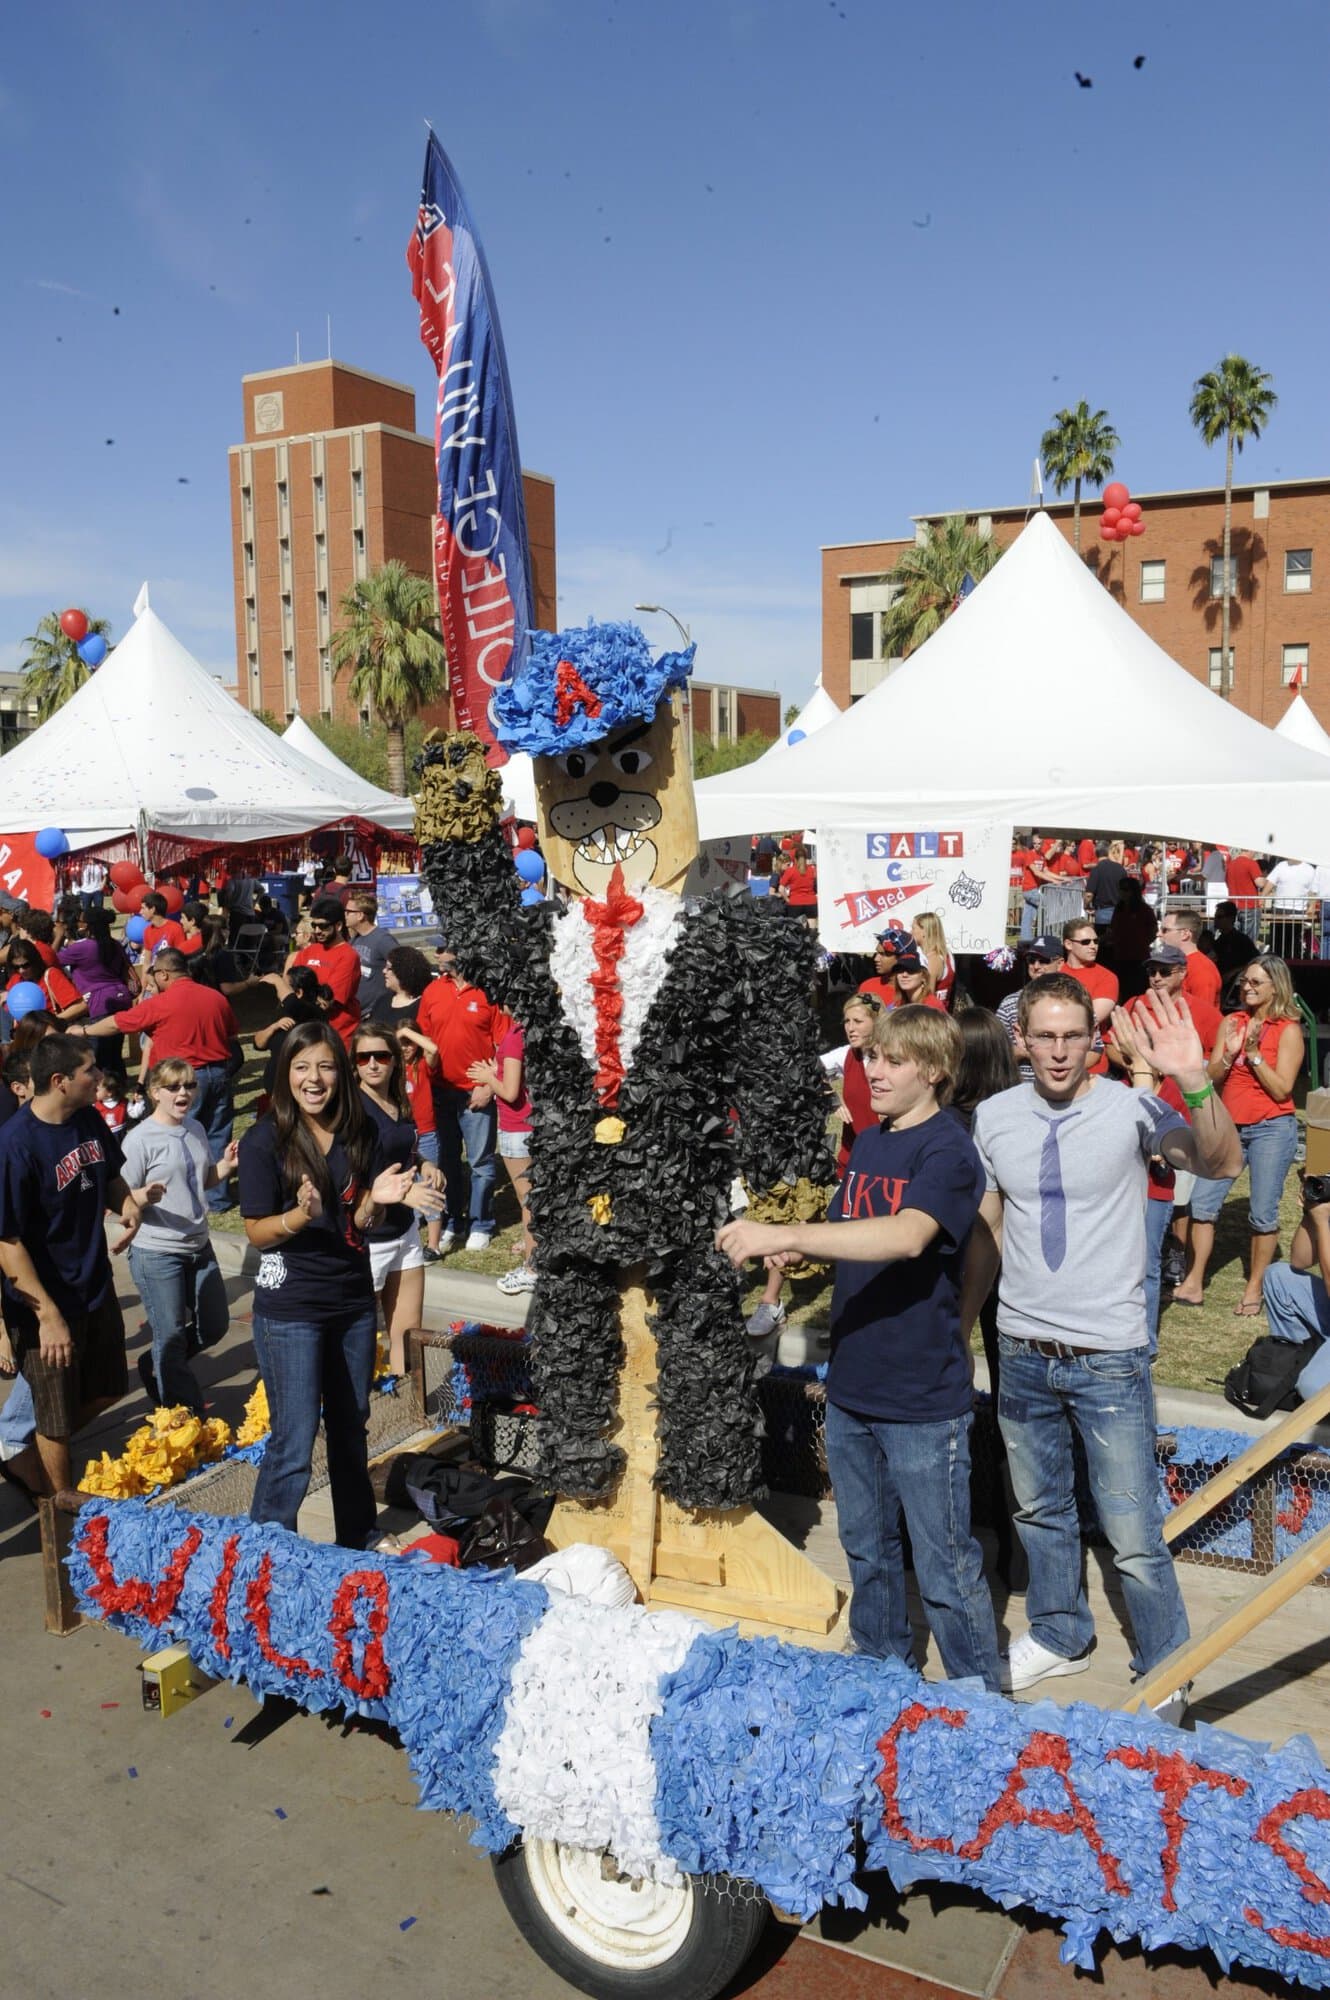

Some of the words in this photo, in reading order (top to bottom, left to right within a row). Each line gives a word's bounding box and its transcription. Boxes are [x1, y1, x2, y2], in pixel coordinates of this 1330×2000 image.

[555, 659, 603, 728] A
[871, 834, 959, 857] SALT
[887, 861, 944, 882] Center
[855, 887, 906, 921] Aged
[874, 1701, 1330, 1959] CATS
